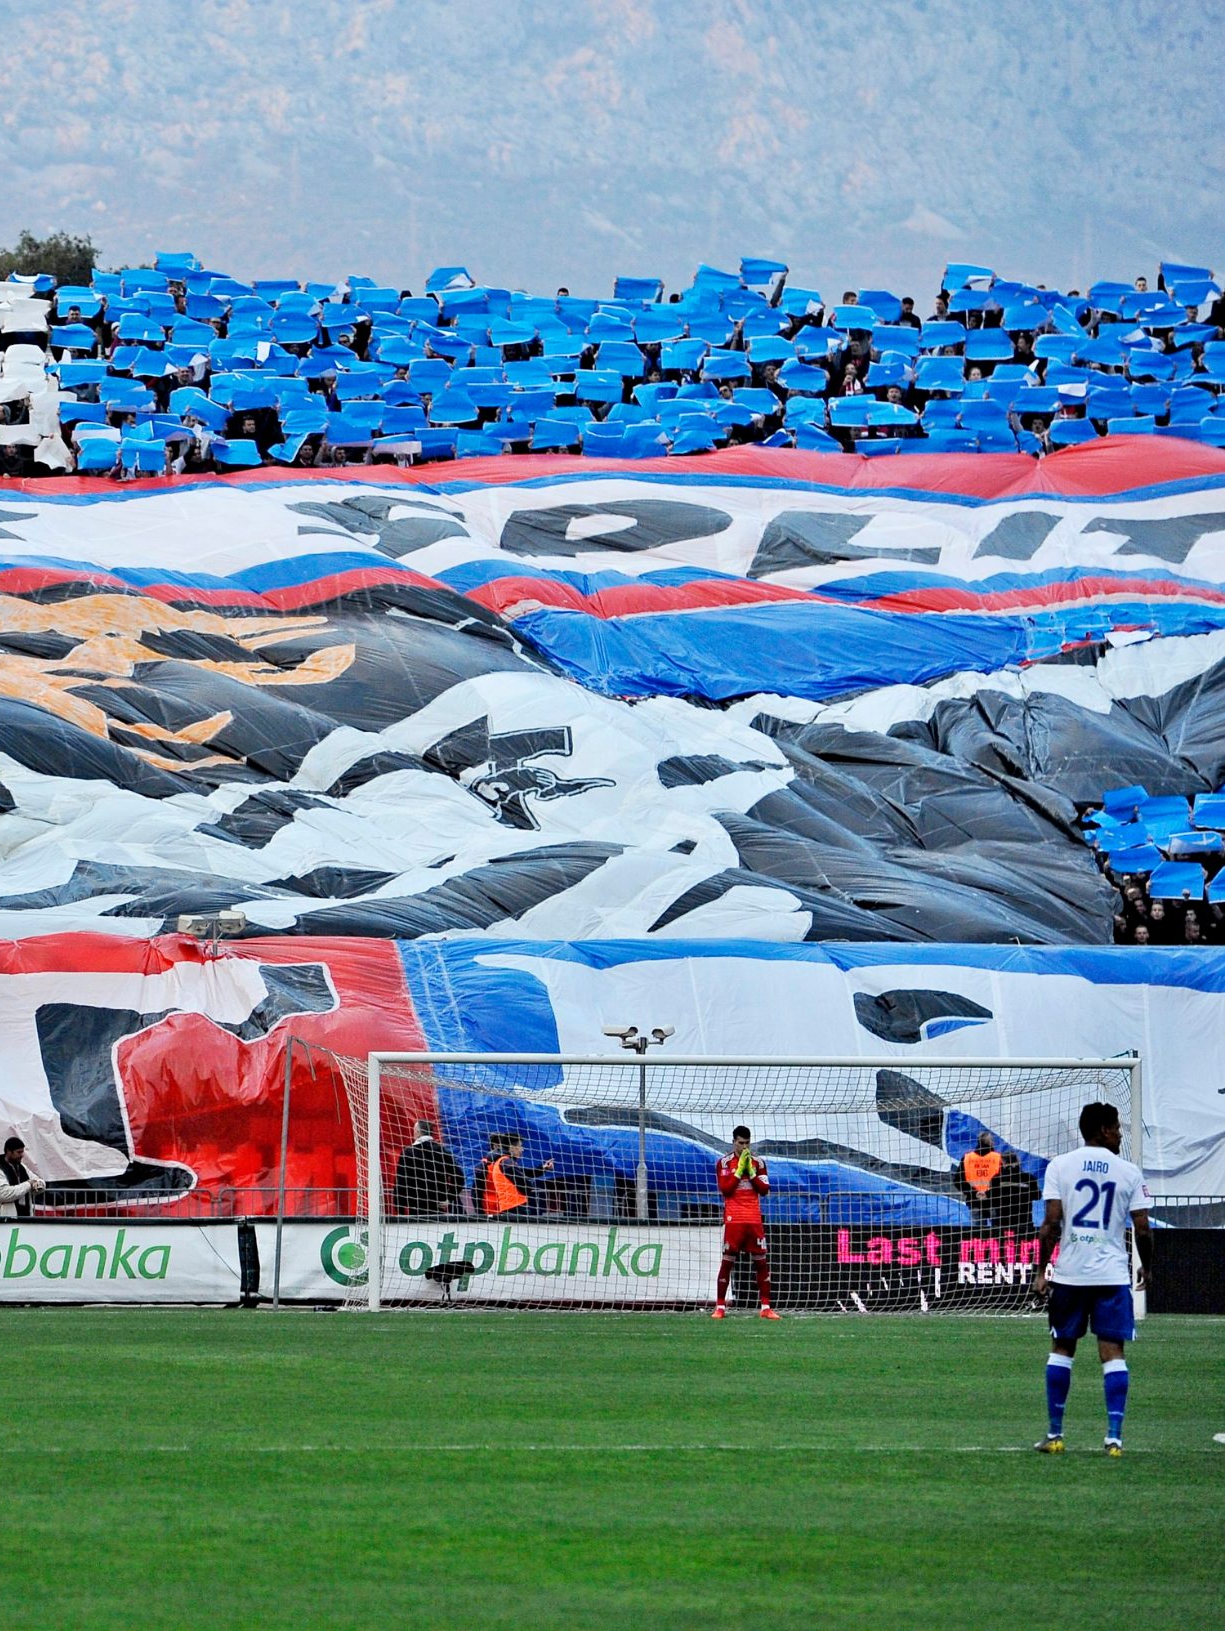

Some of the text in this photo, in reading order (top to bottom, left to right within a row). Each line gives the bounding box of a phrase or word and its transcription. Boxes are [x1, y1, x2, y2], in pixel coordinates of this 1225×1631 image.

[285, 495, 1225, 578] SPLIT
[1083, 1161, 1109, 1174] JAIRO
[1072, 1178, 1117, 1230] 21
[398, 1226, 663, 1292] otpbanka
[838, 1228, 1060, 1265] Last min
[958, 1262, 1032, 1284] RENT
